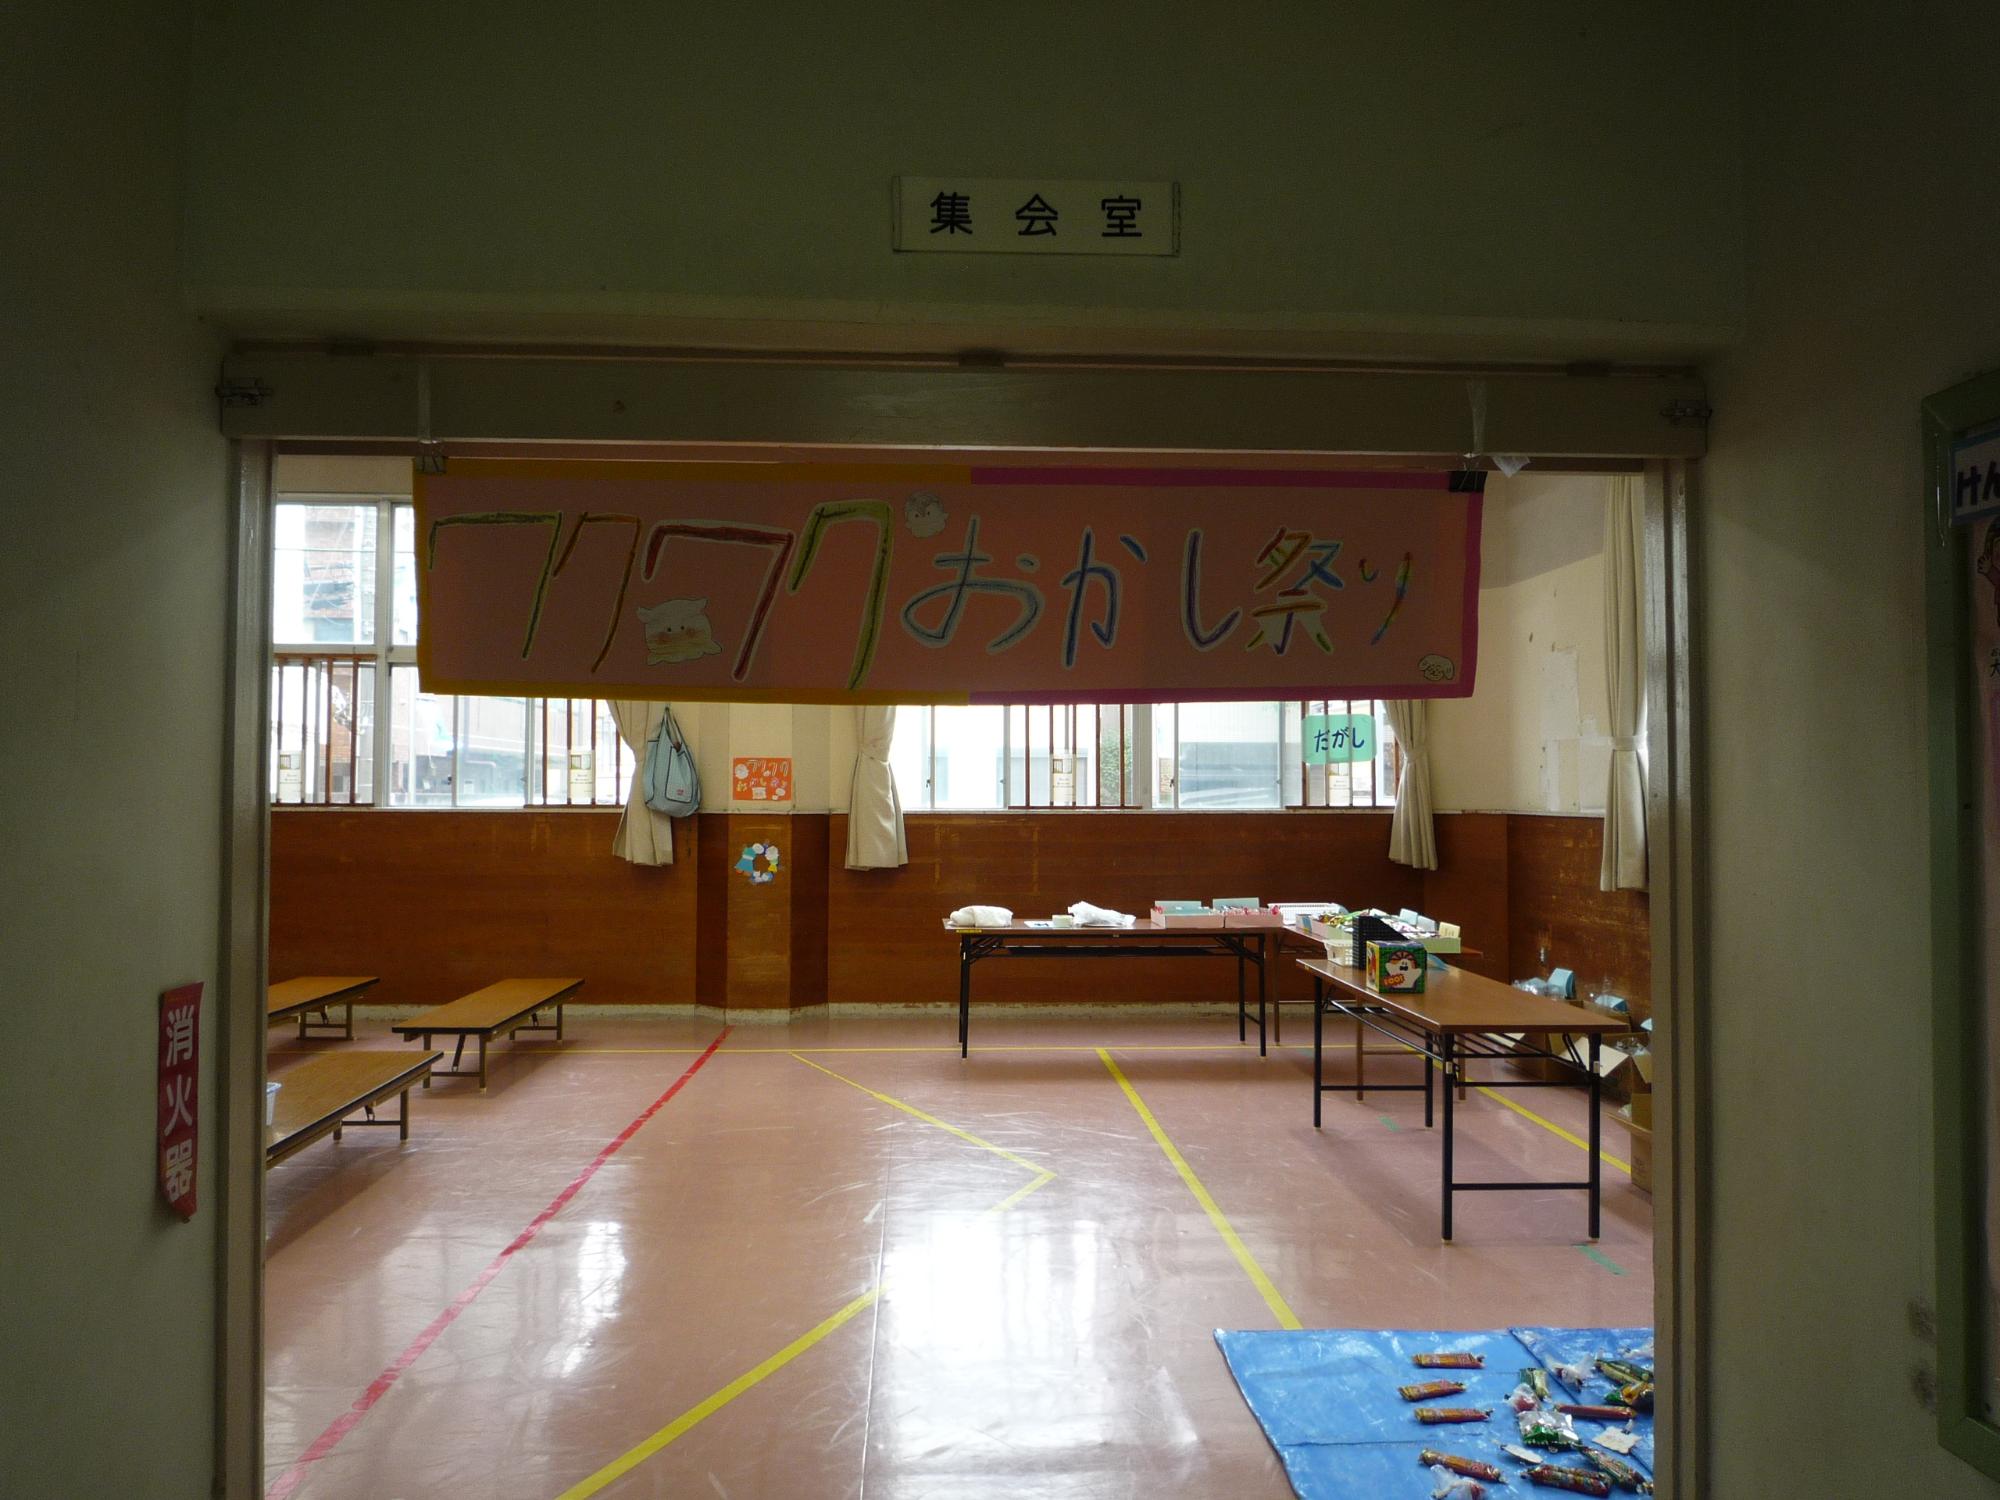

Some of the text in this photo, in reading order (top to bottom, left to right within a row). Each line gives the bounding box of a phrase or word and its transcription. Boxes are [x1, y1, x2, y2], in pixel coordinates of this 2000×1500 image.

[930, 191, 1143, 237] 集会室
[1313, 727, 1365, 753] だがし
[164, 1004, 195, 1203] 消火器
